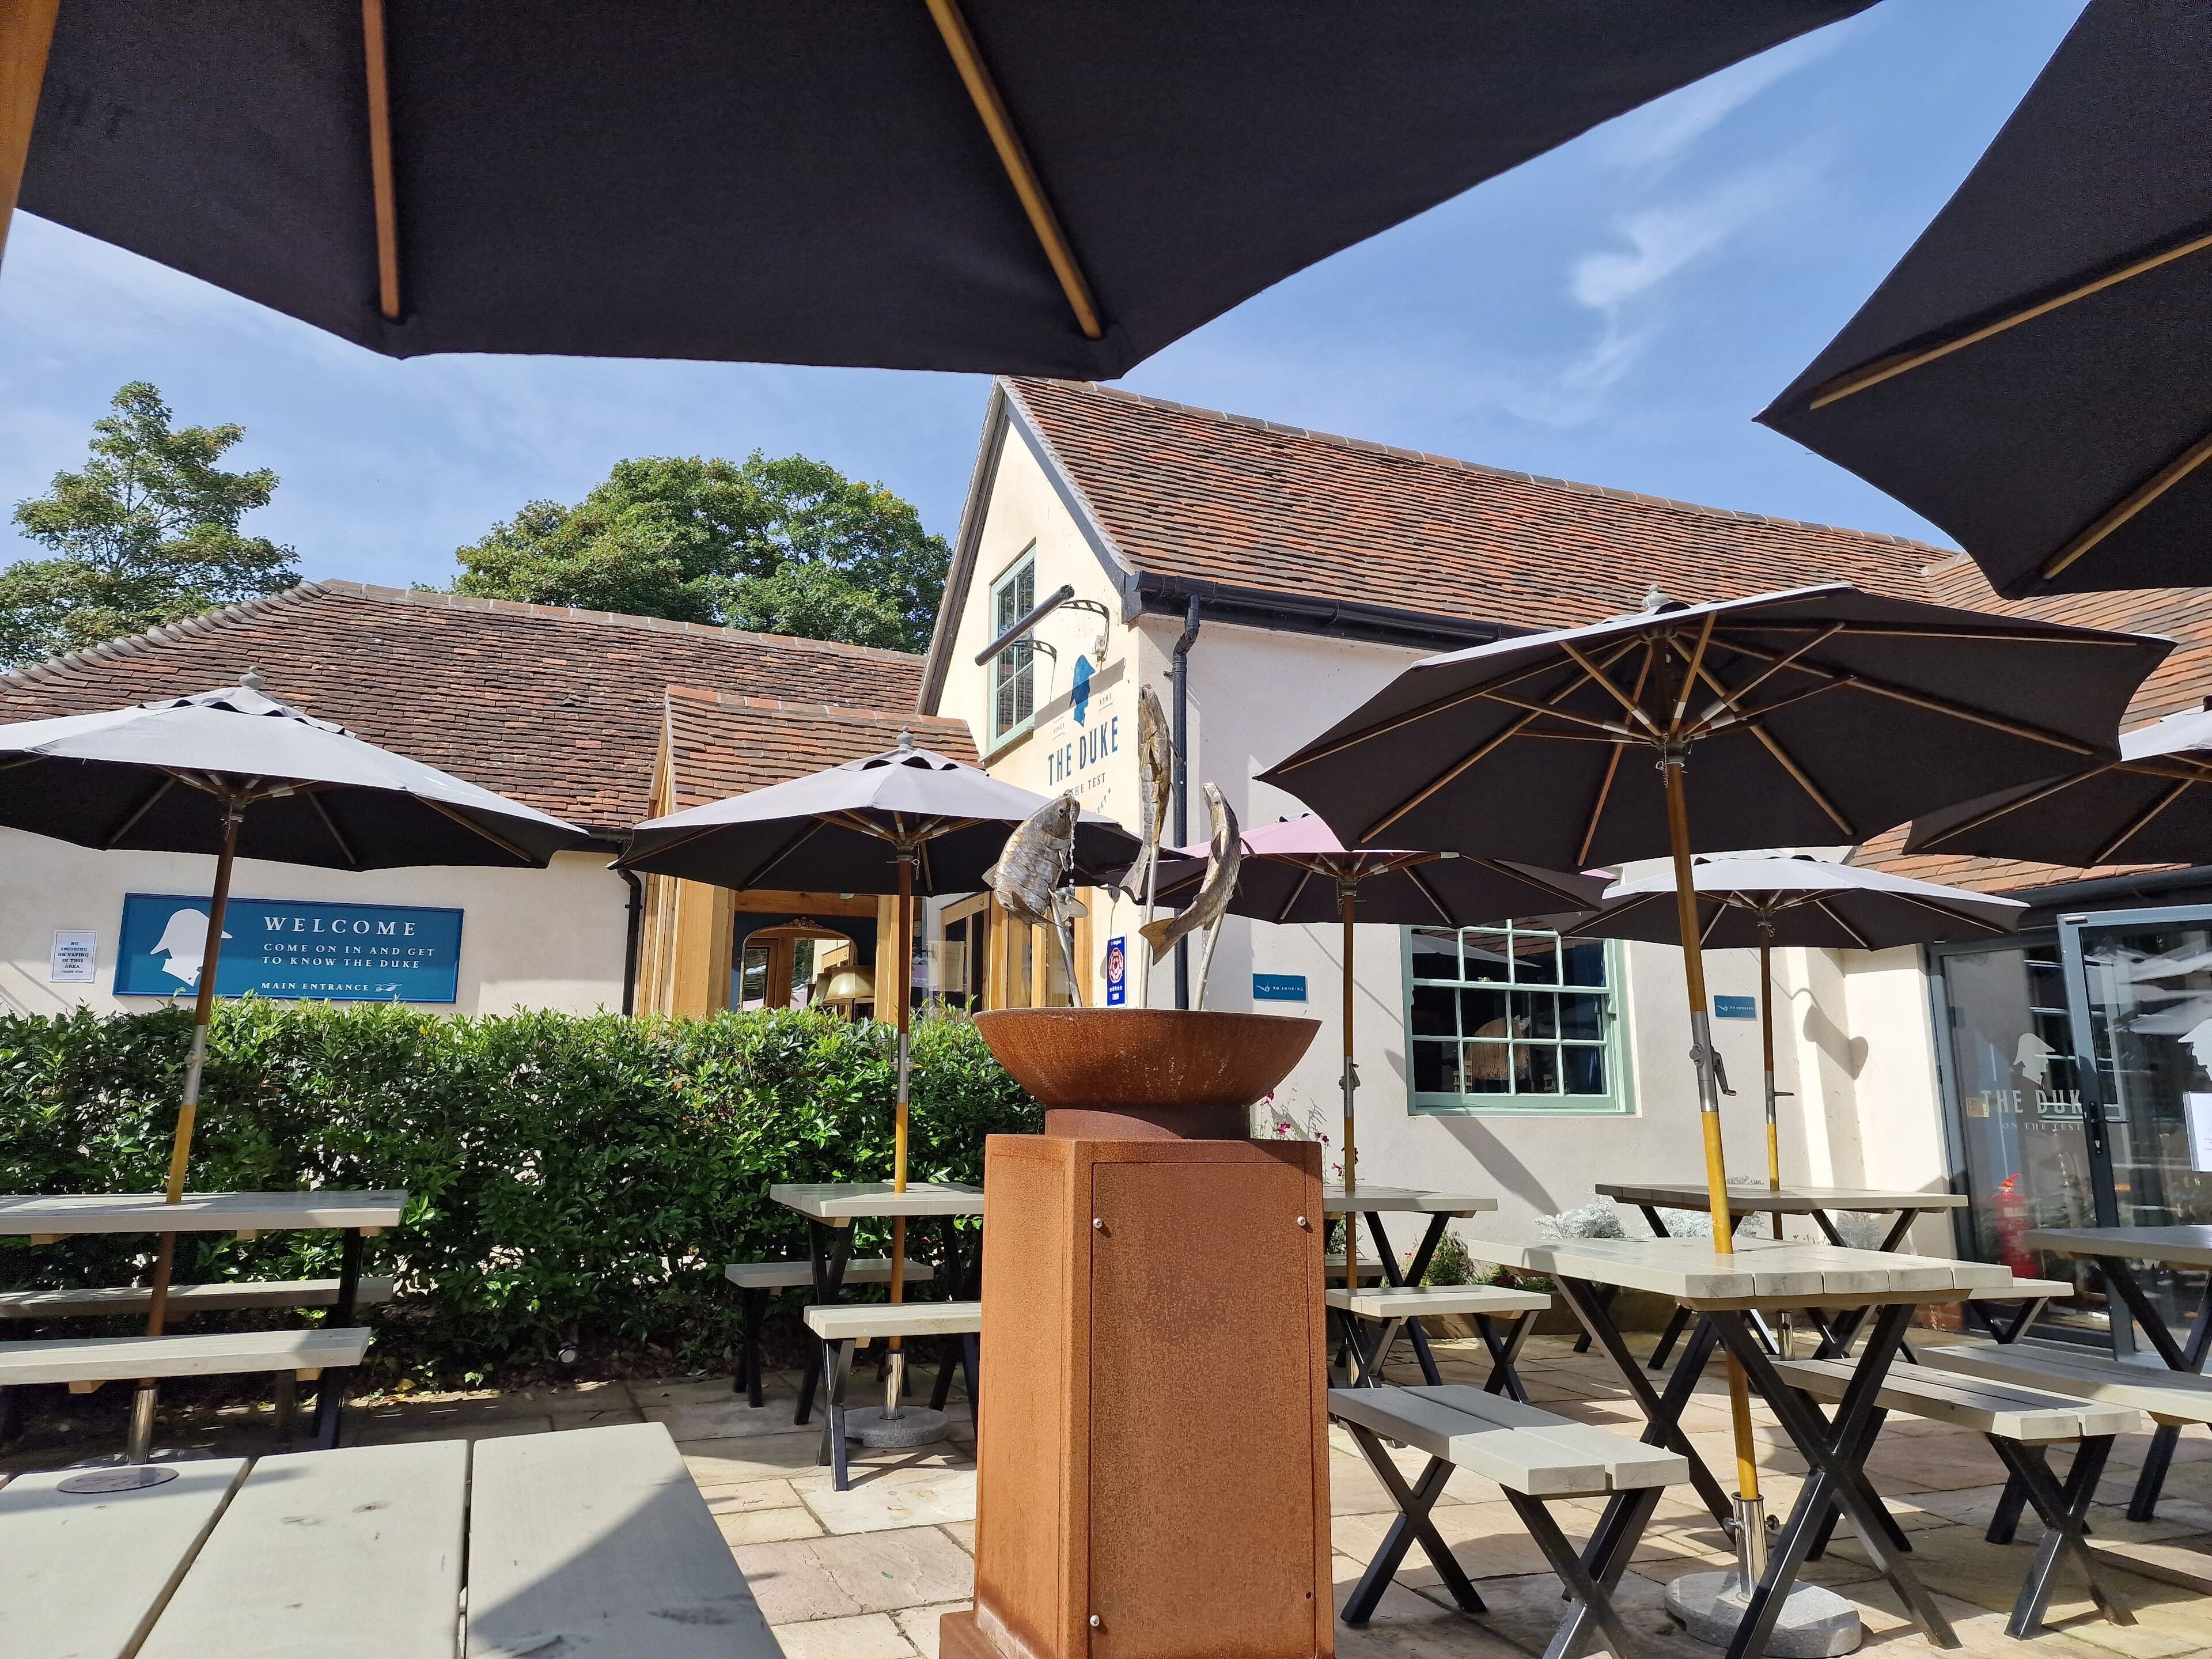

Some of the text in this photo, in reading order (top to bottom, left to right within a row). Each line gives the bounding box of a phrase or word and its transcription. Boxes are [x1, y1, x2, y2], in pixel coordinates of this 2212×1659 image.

[1052, 722, 1065, 734] SINCE
[1048, 715, 1118, 786] THE DUKE
[1088, 772, 1106, 790] TEST
[263, 916, 416, 936] WELCOME
[263, 943, 435, 956] COME ON IN AND GET
[262, 956, 421, 968] TO KNOW THE DUKE
[302, 983, 369, 991] ENTRANCE
[1981, 1089, 2082, 1113] THE DUK
